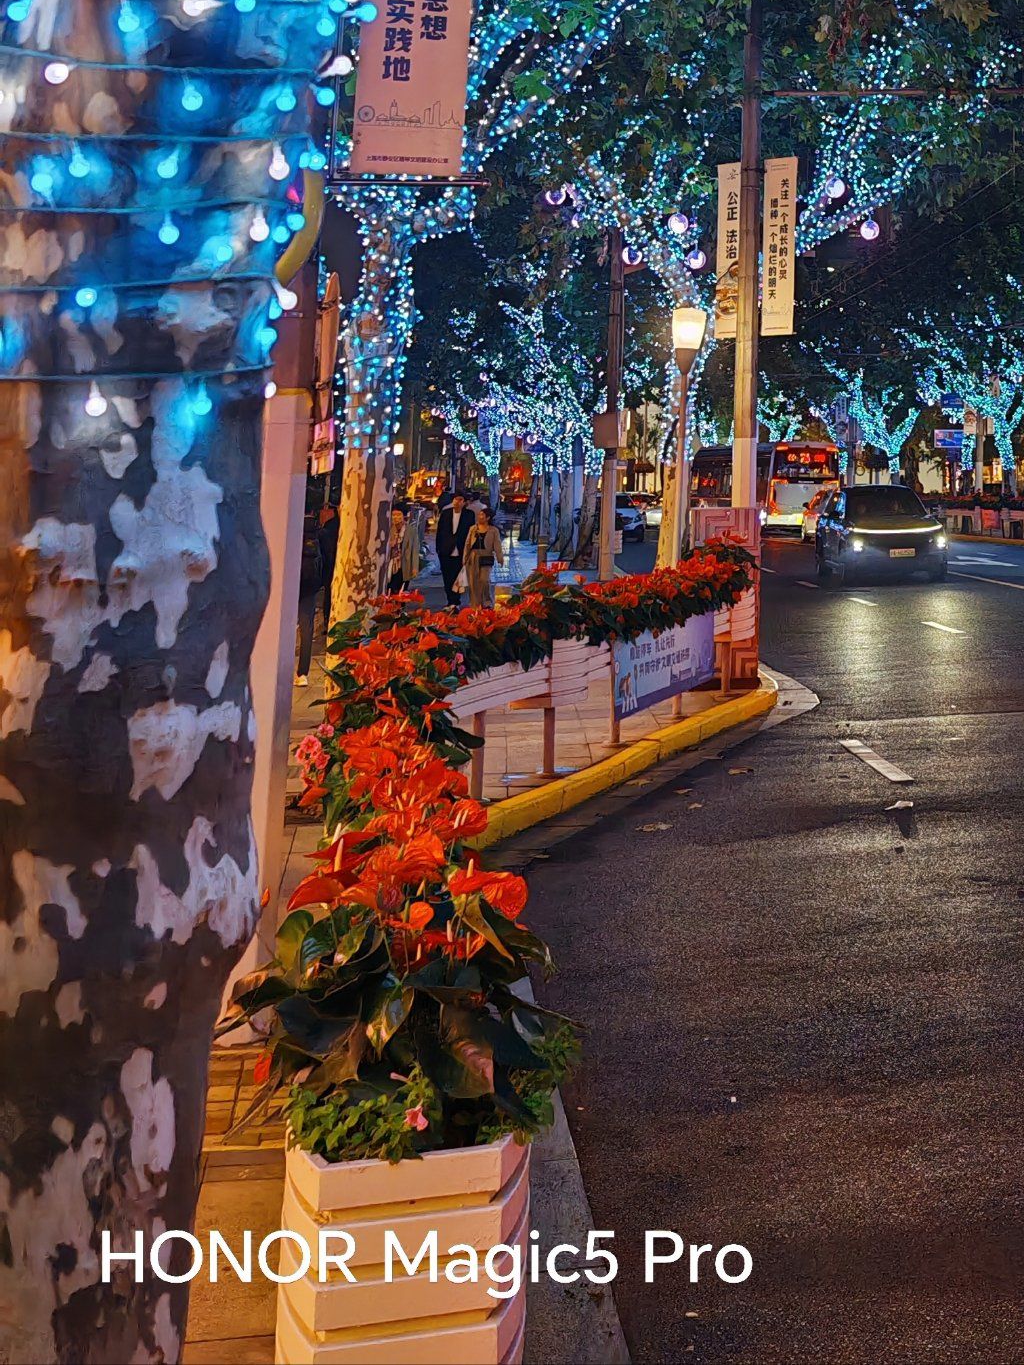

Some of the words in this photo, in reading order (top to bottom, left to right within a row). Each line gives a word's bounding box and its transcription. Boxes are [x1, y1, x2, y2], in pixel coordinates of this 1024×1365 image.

[725, 191, 739, 221] 公正
[725, 229, 739, 260] 法治
[778, 178, 790, 280] 关注一个成长的心灵
